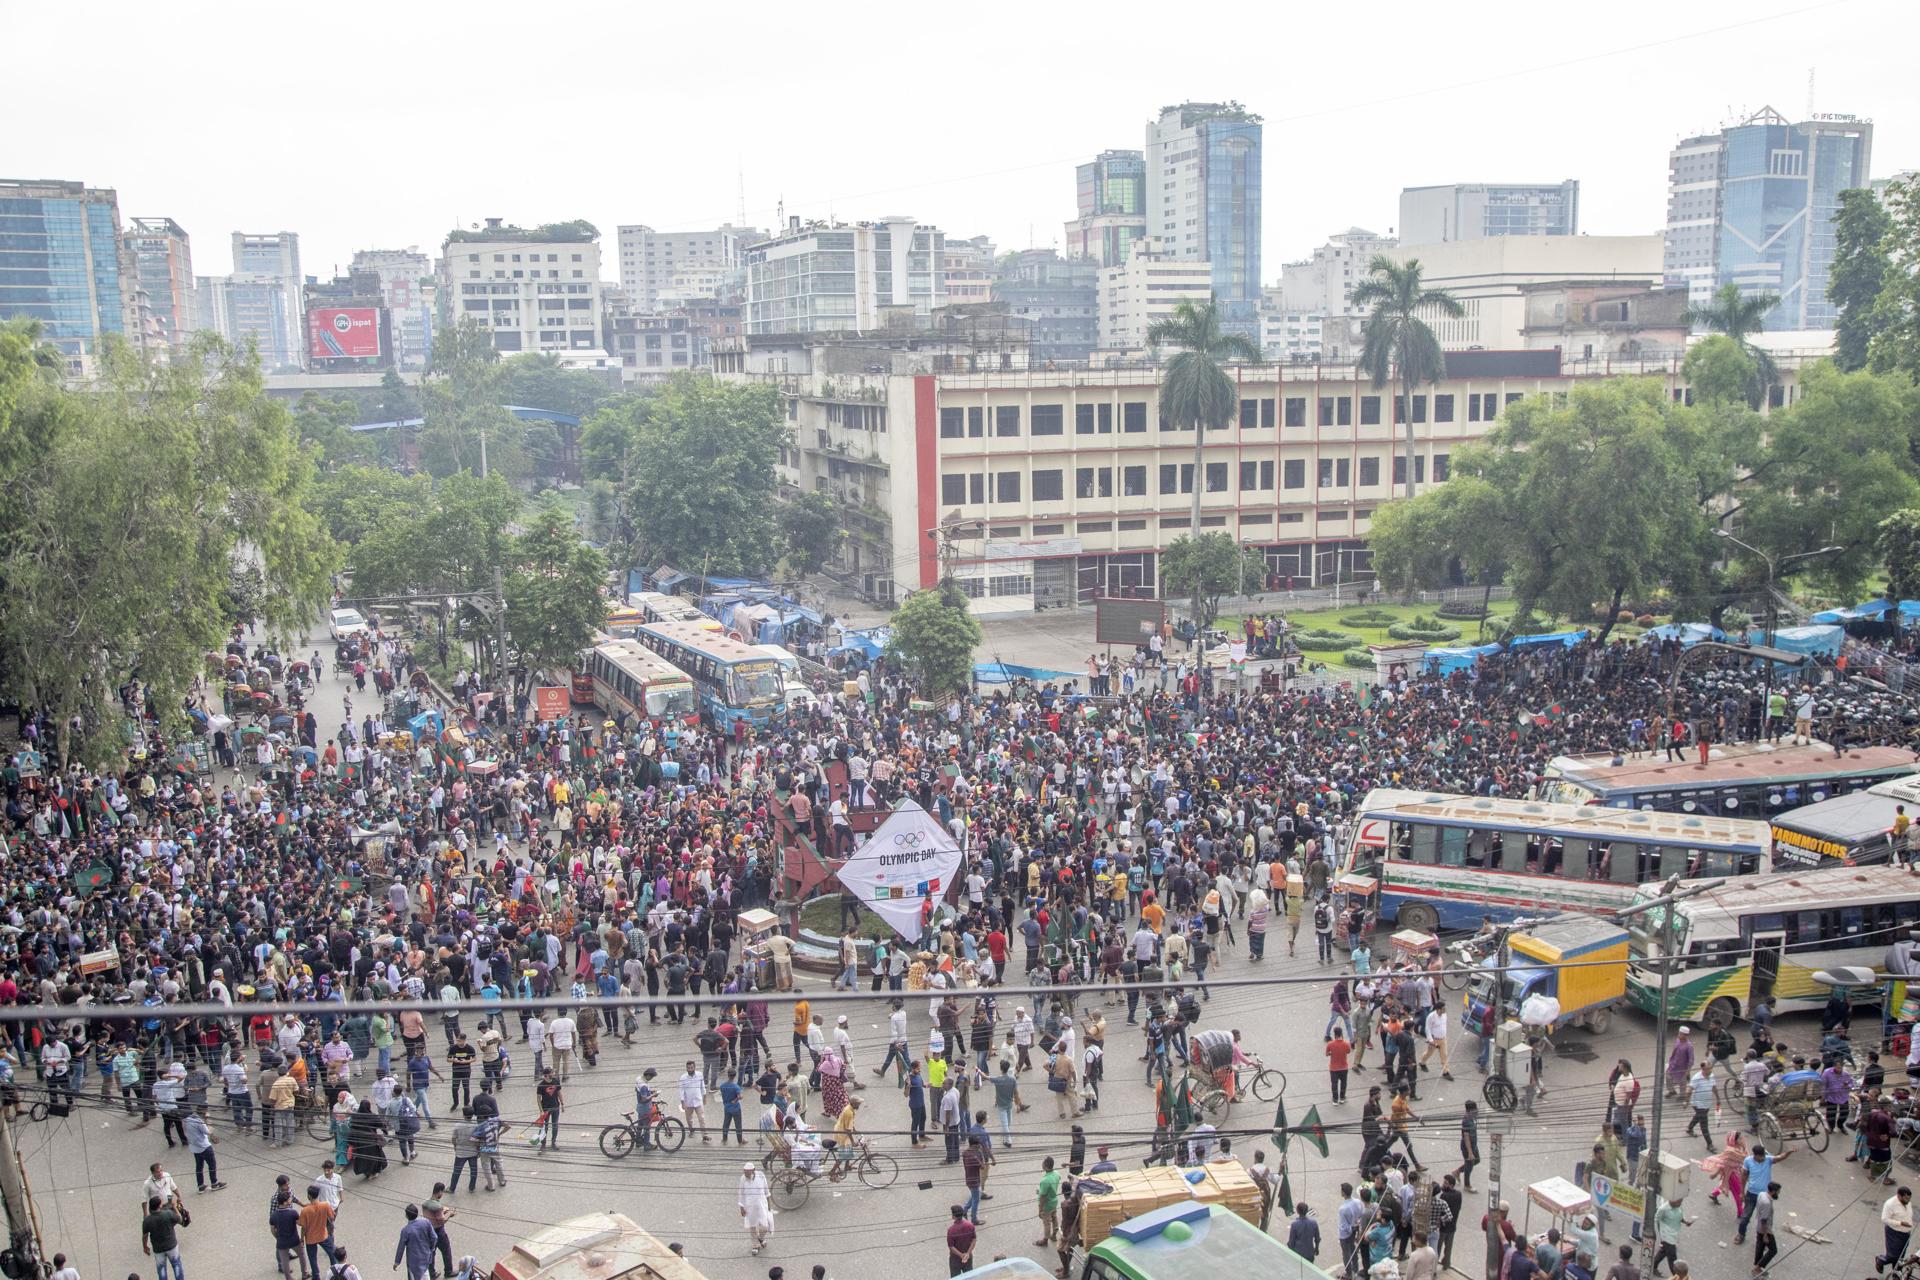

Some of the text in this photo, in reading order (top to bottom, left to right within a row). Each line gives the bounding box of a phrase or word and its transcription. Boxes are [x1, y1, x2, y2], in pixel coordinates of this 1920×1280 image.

[1834, 113, 1856, 121] TOWER
[352, 319, 371, 327] ispat
[879, 848, 937, 866] OLYMPIC DAY
